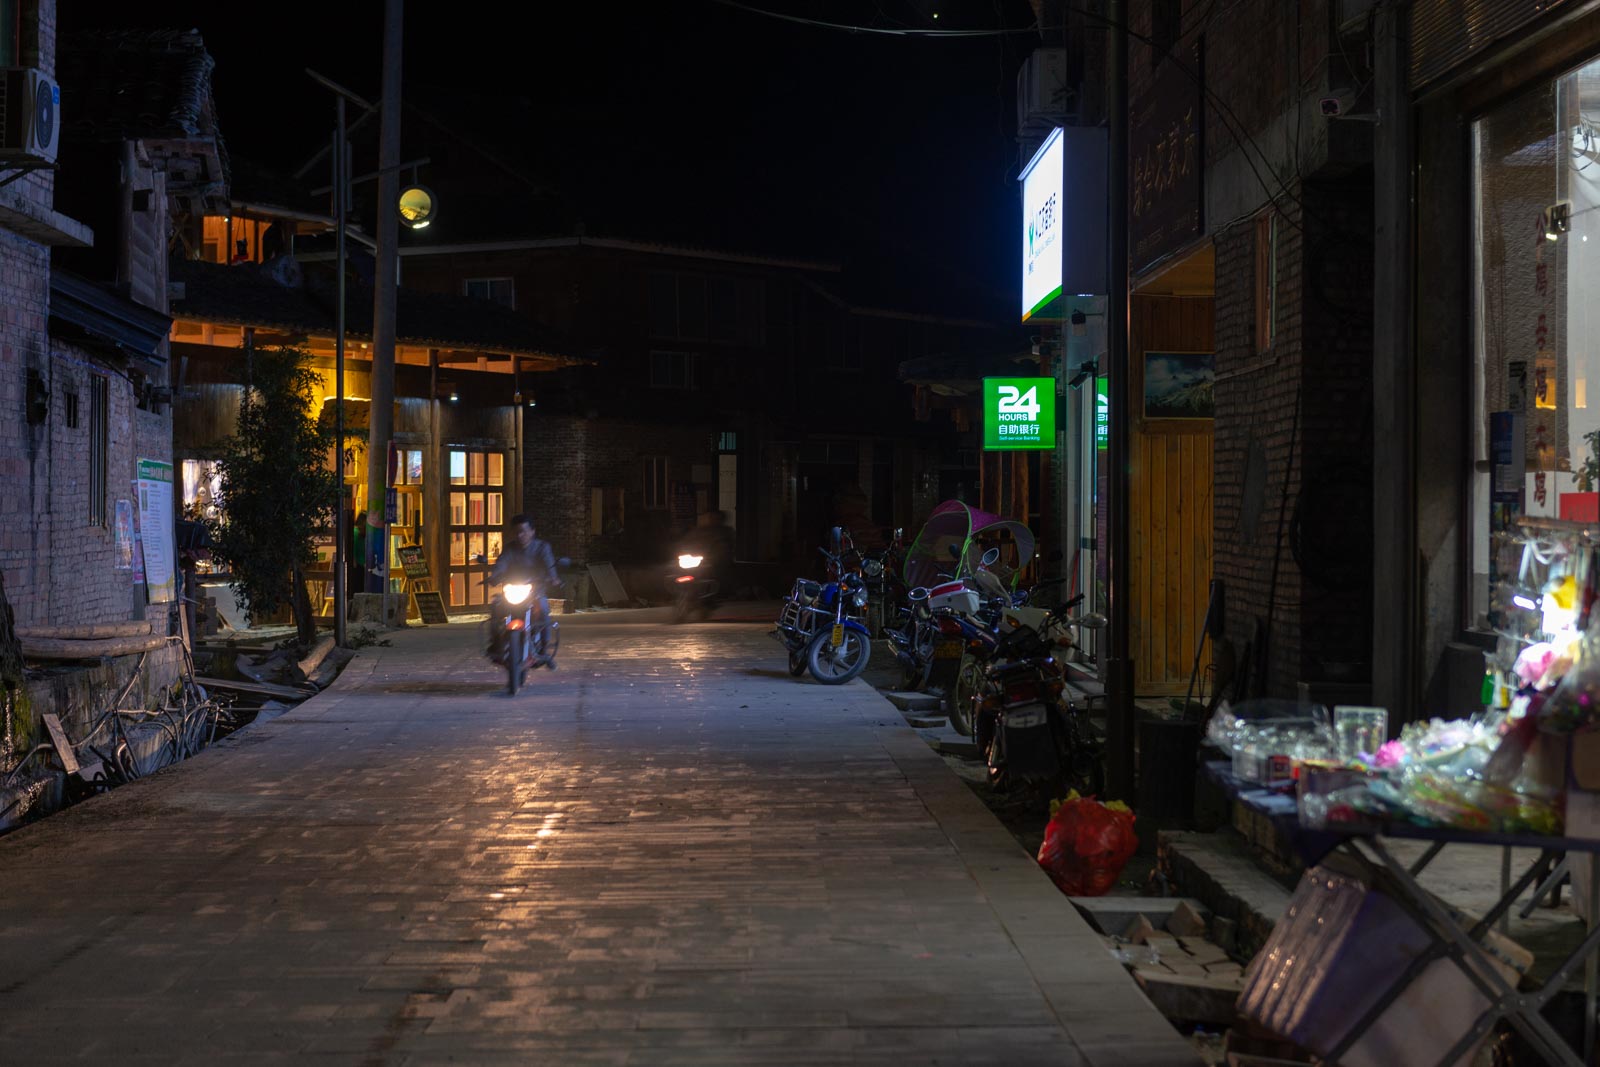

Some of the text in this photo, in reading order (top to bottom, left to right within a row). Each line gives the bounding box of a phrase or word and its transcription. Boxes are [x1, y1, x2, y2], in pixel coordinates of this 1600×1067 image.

[999, 386, 1040, 421] 24
[999, 413, 1028, 421] HOURS
[999, 424, 1040, 435] 自助银行
